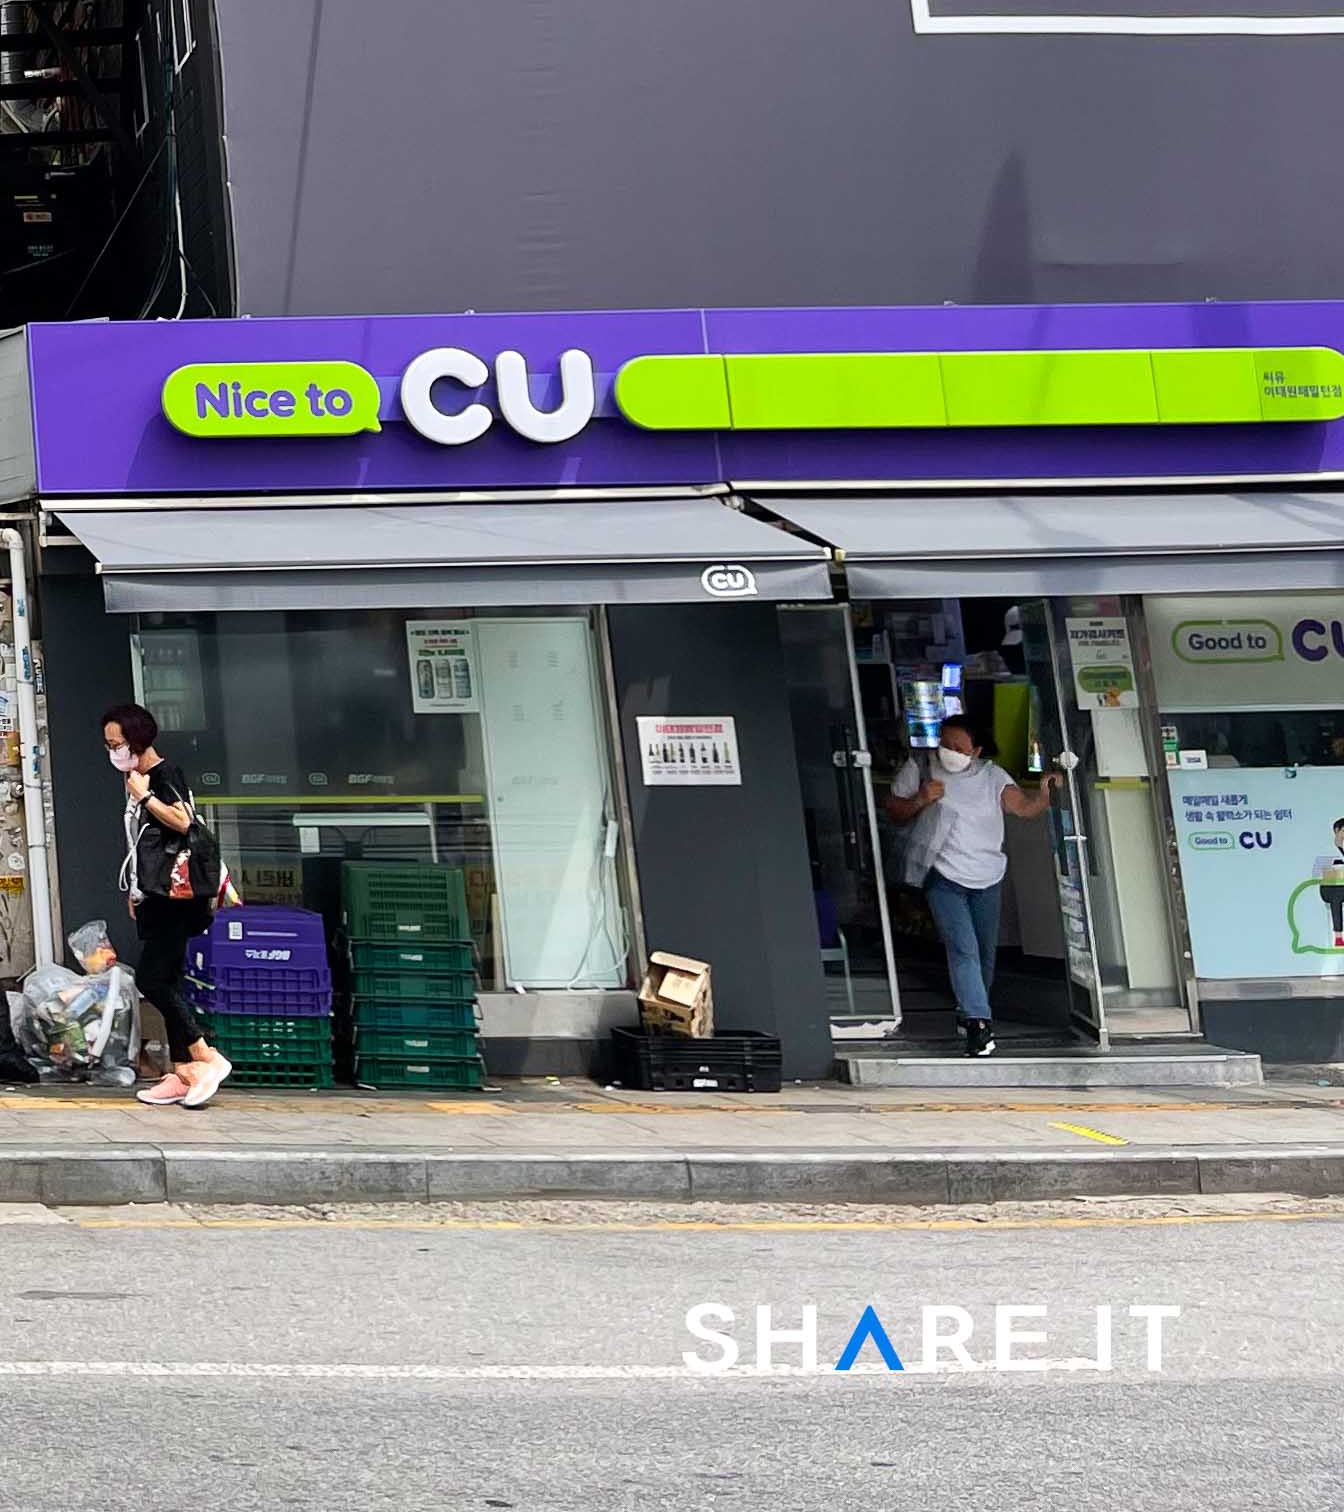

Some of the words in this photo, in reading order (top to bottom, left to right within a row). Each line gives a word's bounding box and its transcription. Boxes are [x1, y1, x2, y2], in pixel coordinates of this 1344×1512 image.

[195, 381, 296, 420] Nice
[305, 382, 353, 419] to
[399, 345, 596, 446] CU
[712, 572, 745, 589] CU
[1188, 631, 1243, 651] Good
[1247, 632, 1268, 650] to
[1194, 836, 1218, 846] Good
[1238, 831, 1272, 850] CU
